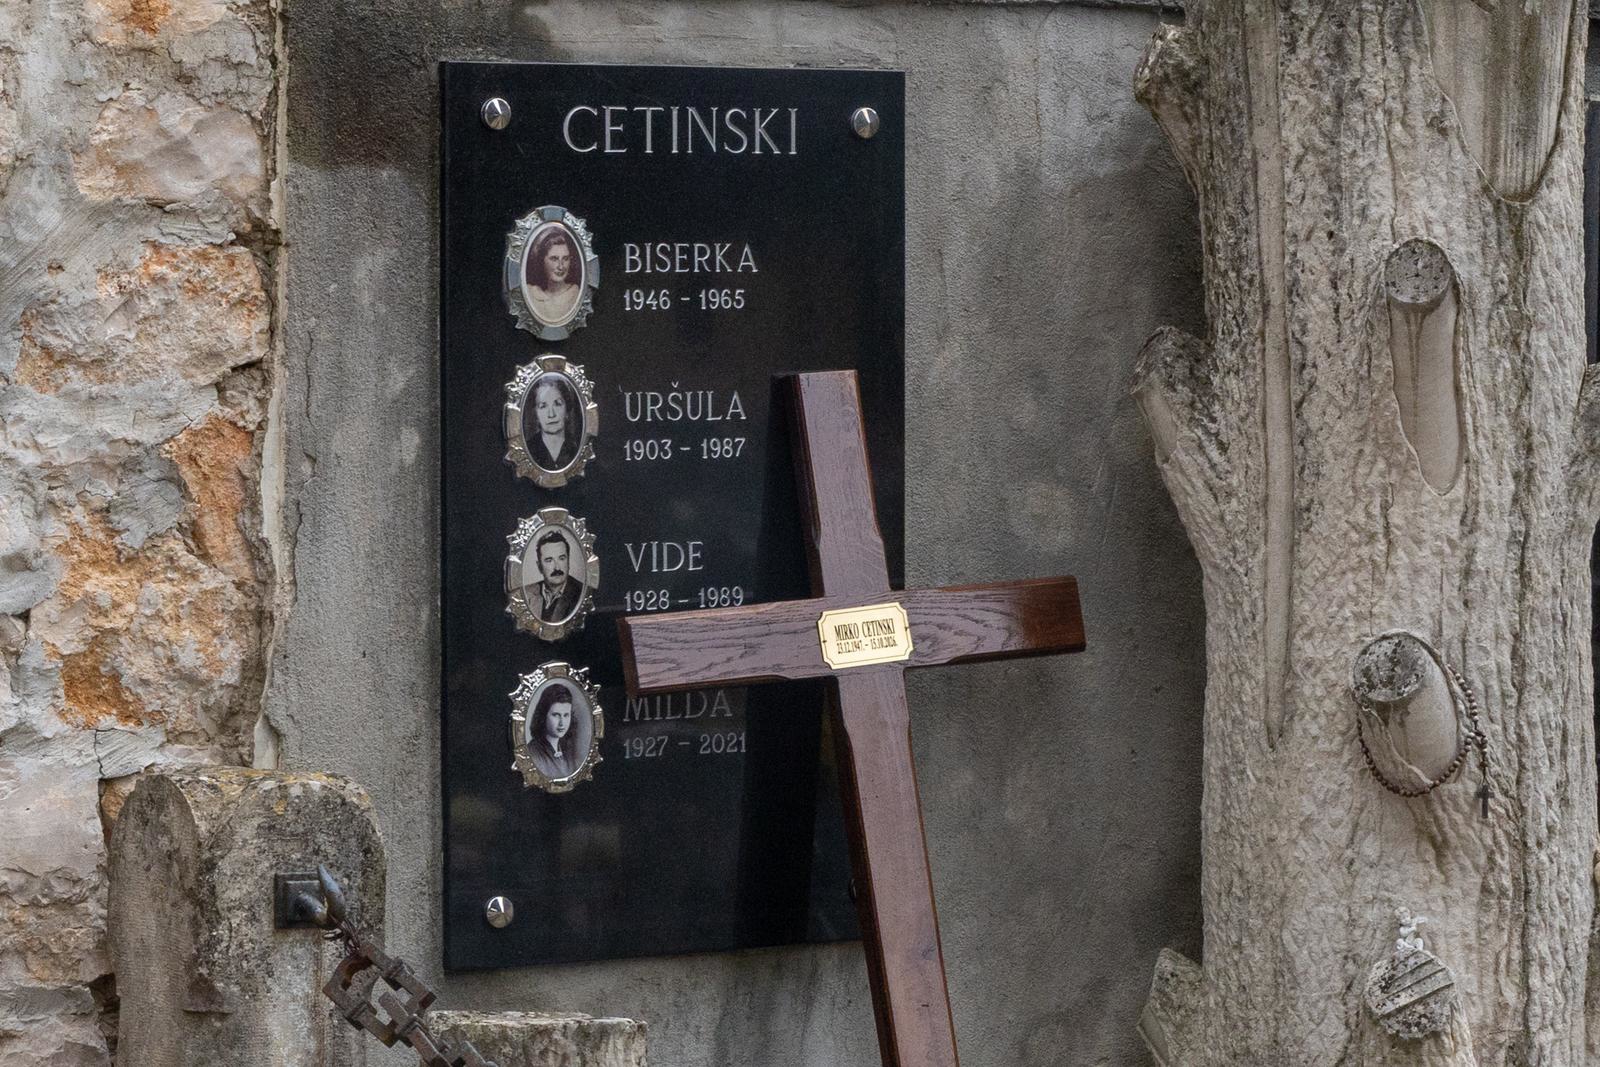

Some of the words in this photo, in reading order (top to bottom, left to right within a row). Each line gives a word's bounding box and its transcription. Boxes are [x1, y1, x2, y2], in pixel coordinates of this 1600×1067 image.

[562, 105, 799, 155] CETINSKI
[624, 242, 759, 274] BISERKA
[623, 288, 671, 311] 1946
[699, 288, 746, 310] 1965
[624, 380, 747, 422] URŠULA
[624, 438, 672, 461] 1903
[700, 437, 746, 460] 1987
[624, 540, 704, 573] VIDE
[624, 589, 670, 612] 1928
[698, 585, 744, 608] 1989
[834, 622, 860, 641] MIRKO
[861, 618, 896, 638] CETINSKI
[623, 690, 733, 722] MILDA
[623, 735, 668, 759] 1927
[699, 731, 747, 754] 2021
